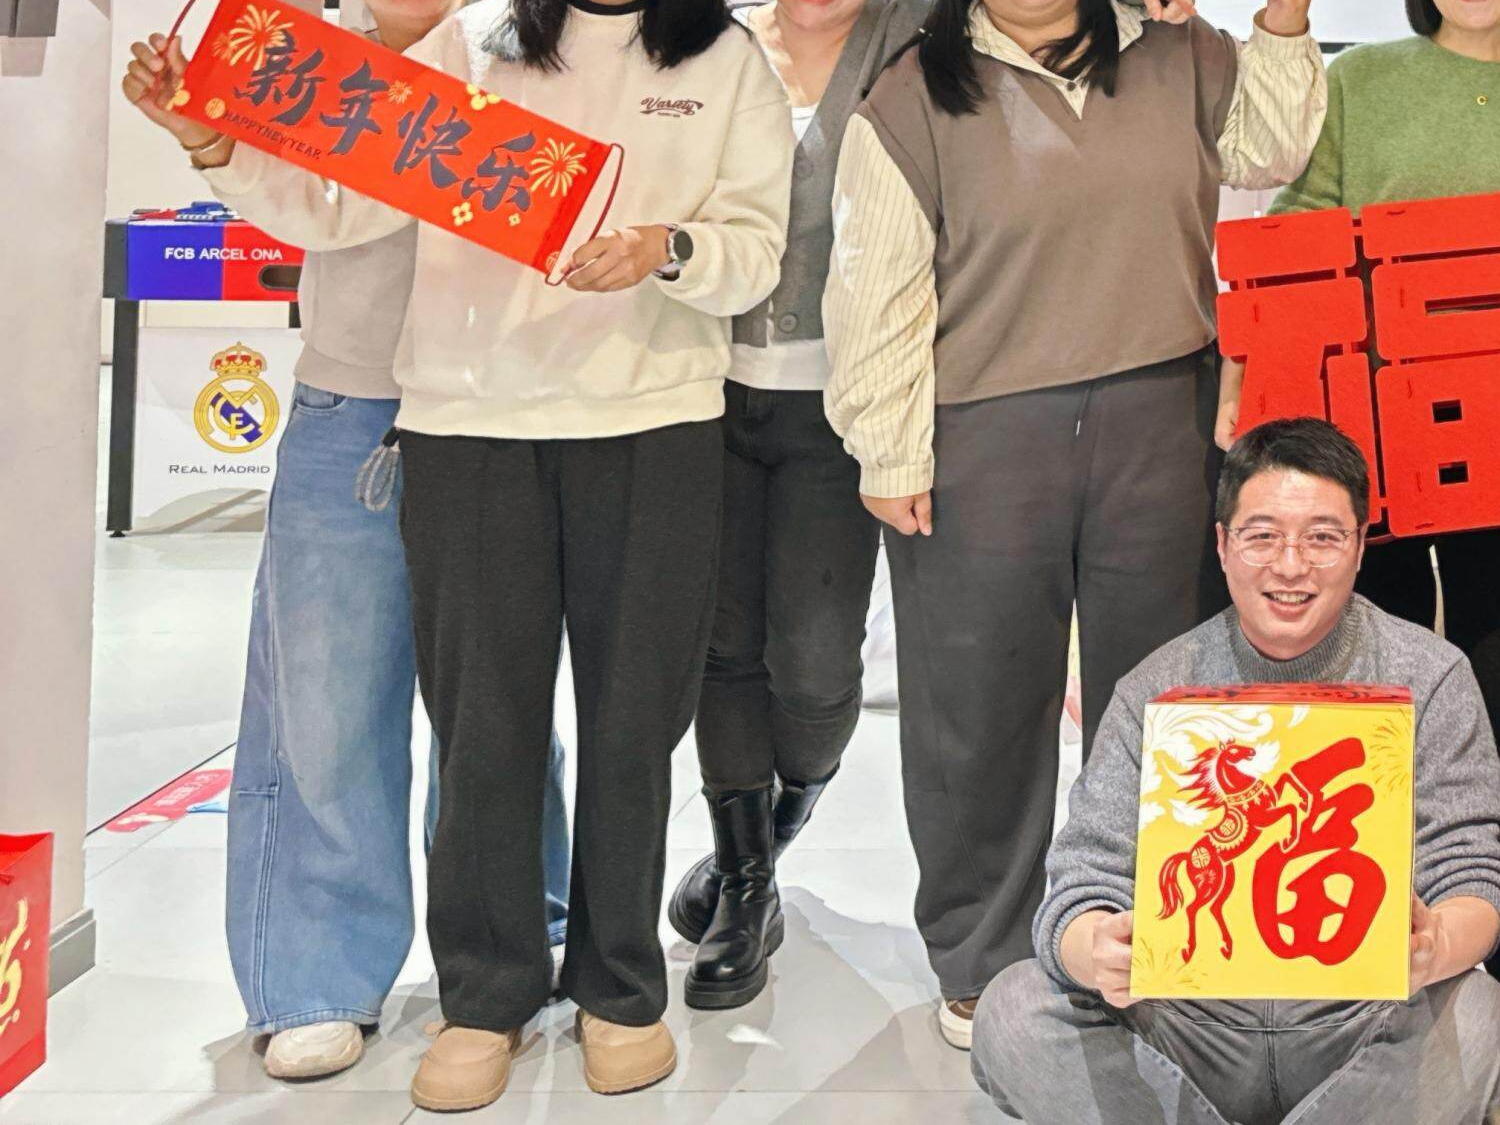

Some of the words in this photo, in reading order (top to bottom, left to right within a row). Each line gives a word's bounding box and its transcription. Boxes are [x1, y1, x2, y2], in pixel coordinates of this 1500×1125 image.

[233, 28, 537, 214] 新年快乐
[164, 247, 196, 260] FCB
[1252, 736, 1387, 966] 福
